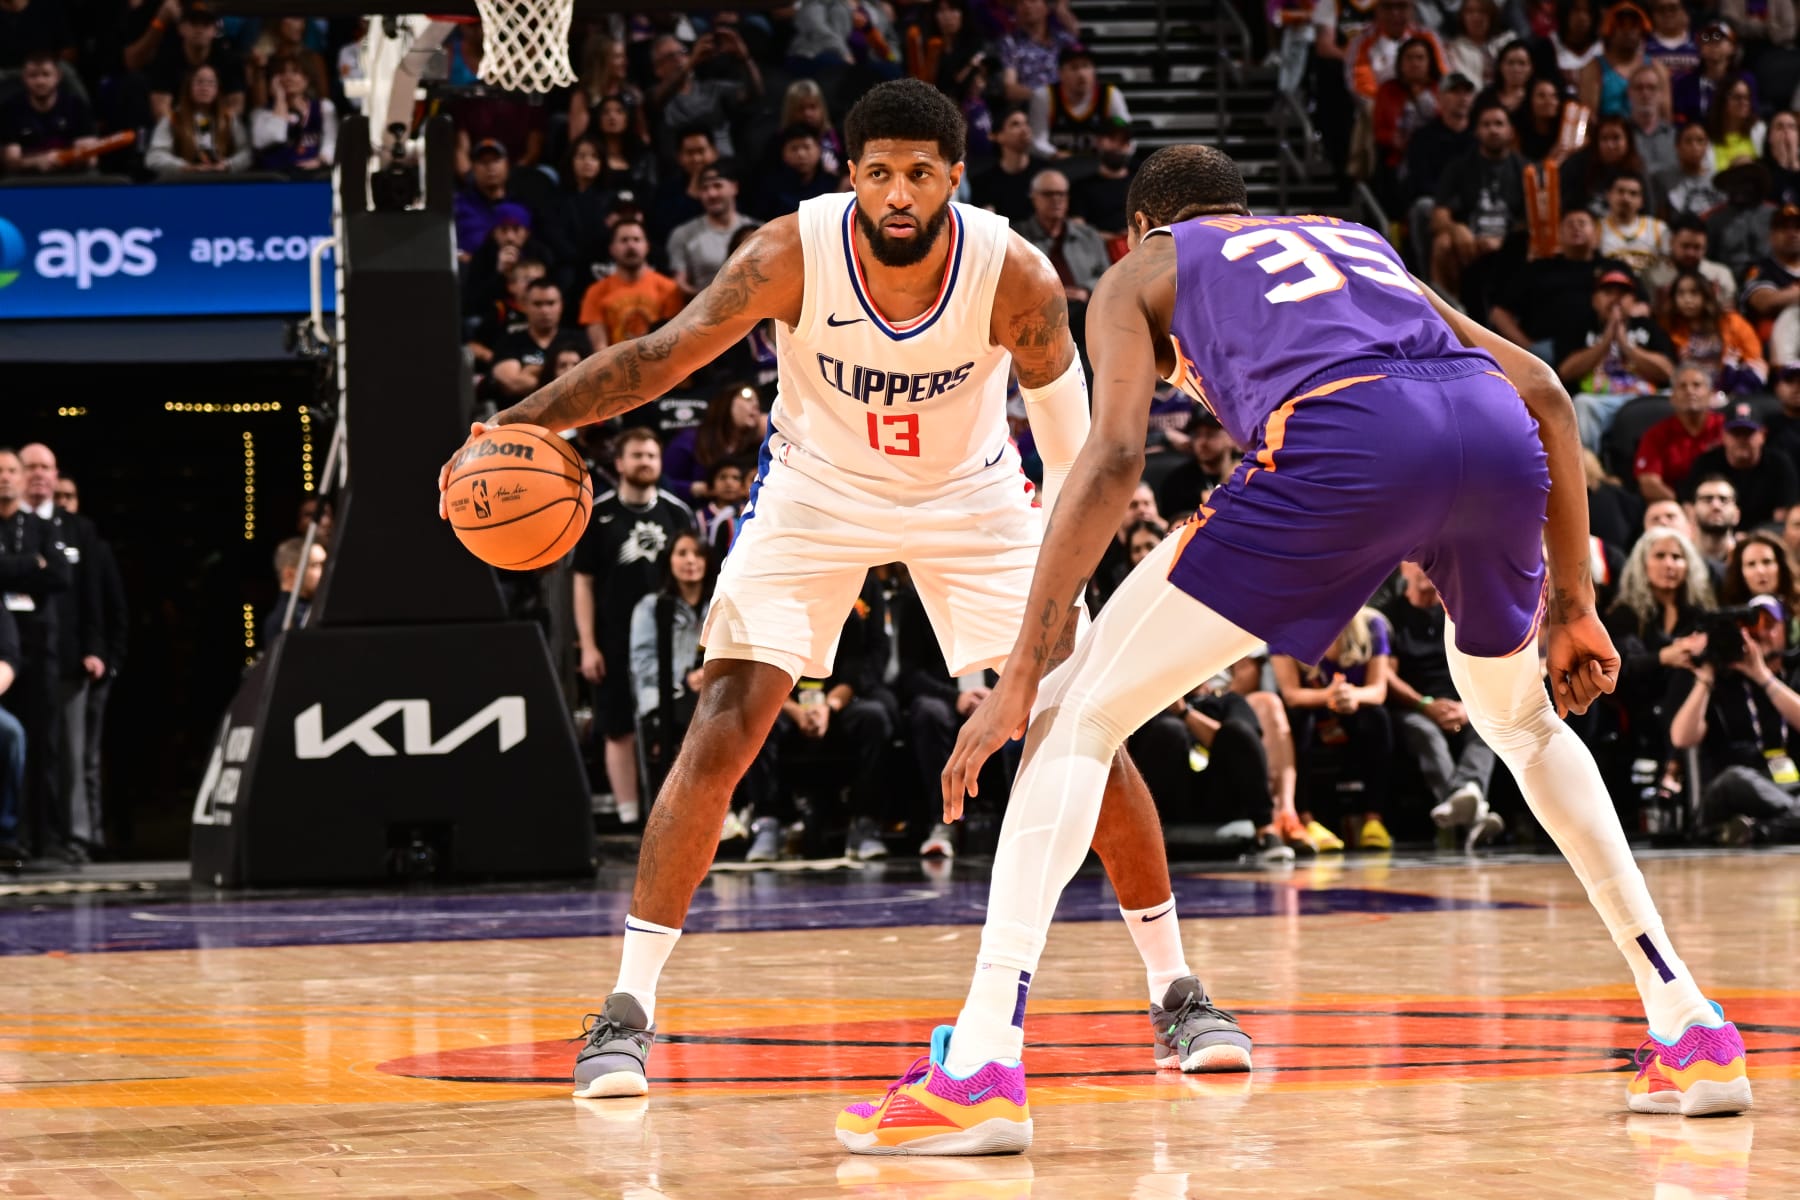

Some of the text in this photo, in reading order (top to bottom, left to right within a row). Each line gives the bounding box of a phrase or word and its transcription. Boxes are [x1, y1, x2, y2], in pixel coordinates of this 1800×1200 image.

[34, 227, 159, 290] aps
[1220, 226, 1424, 304] 35
[816, 352, 975, 406] CLIPPERS
[866, 411, 920, 457] 13
[294, 696, 527, 760] KIA
